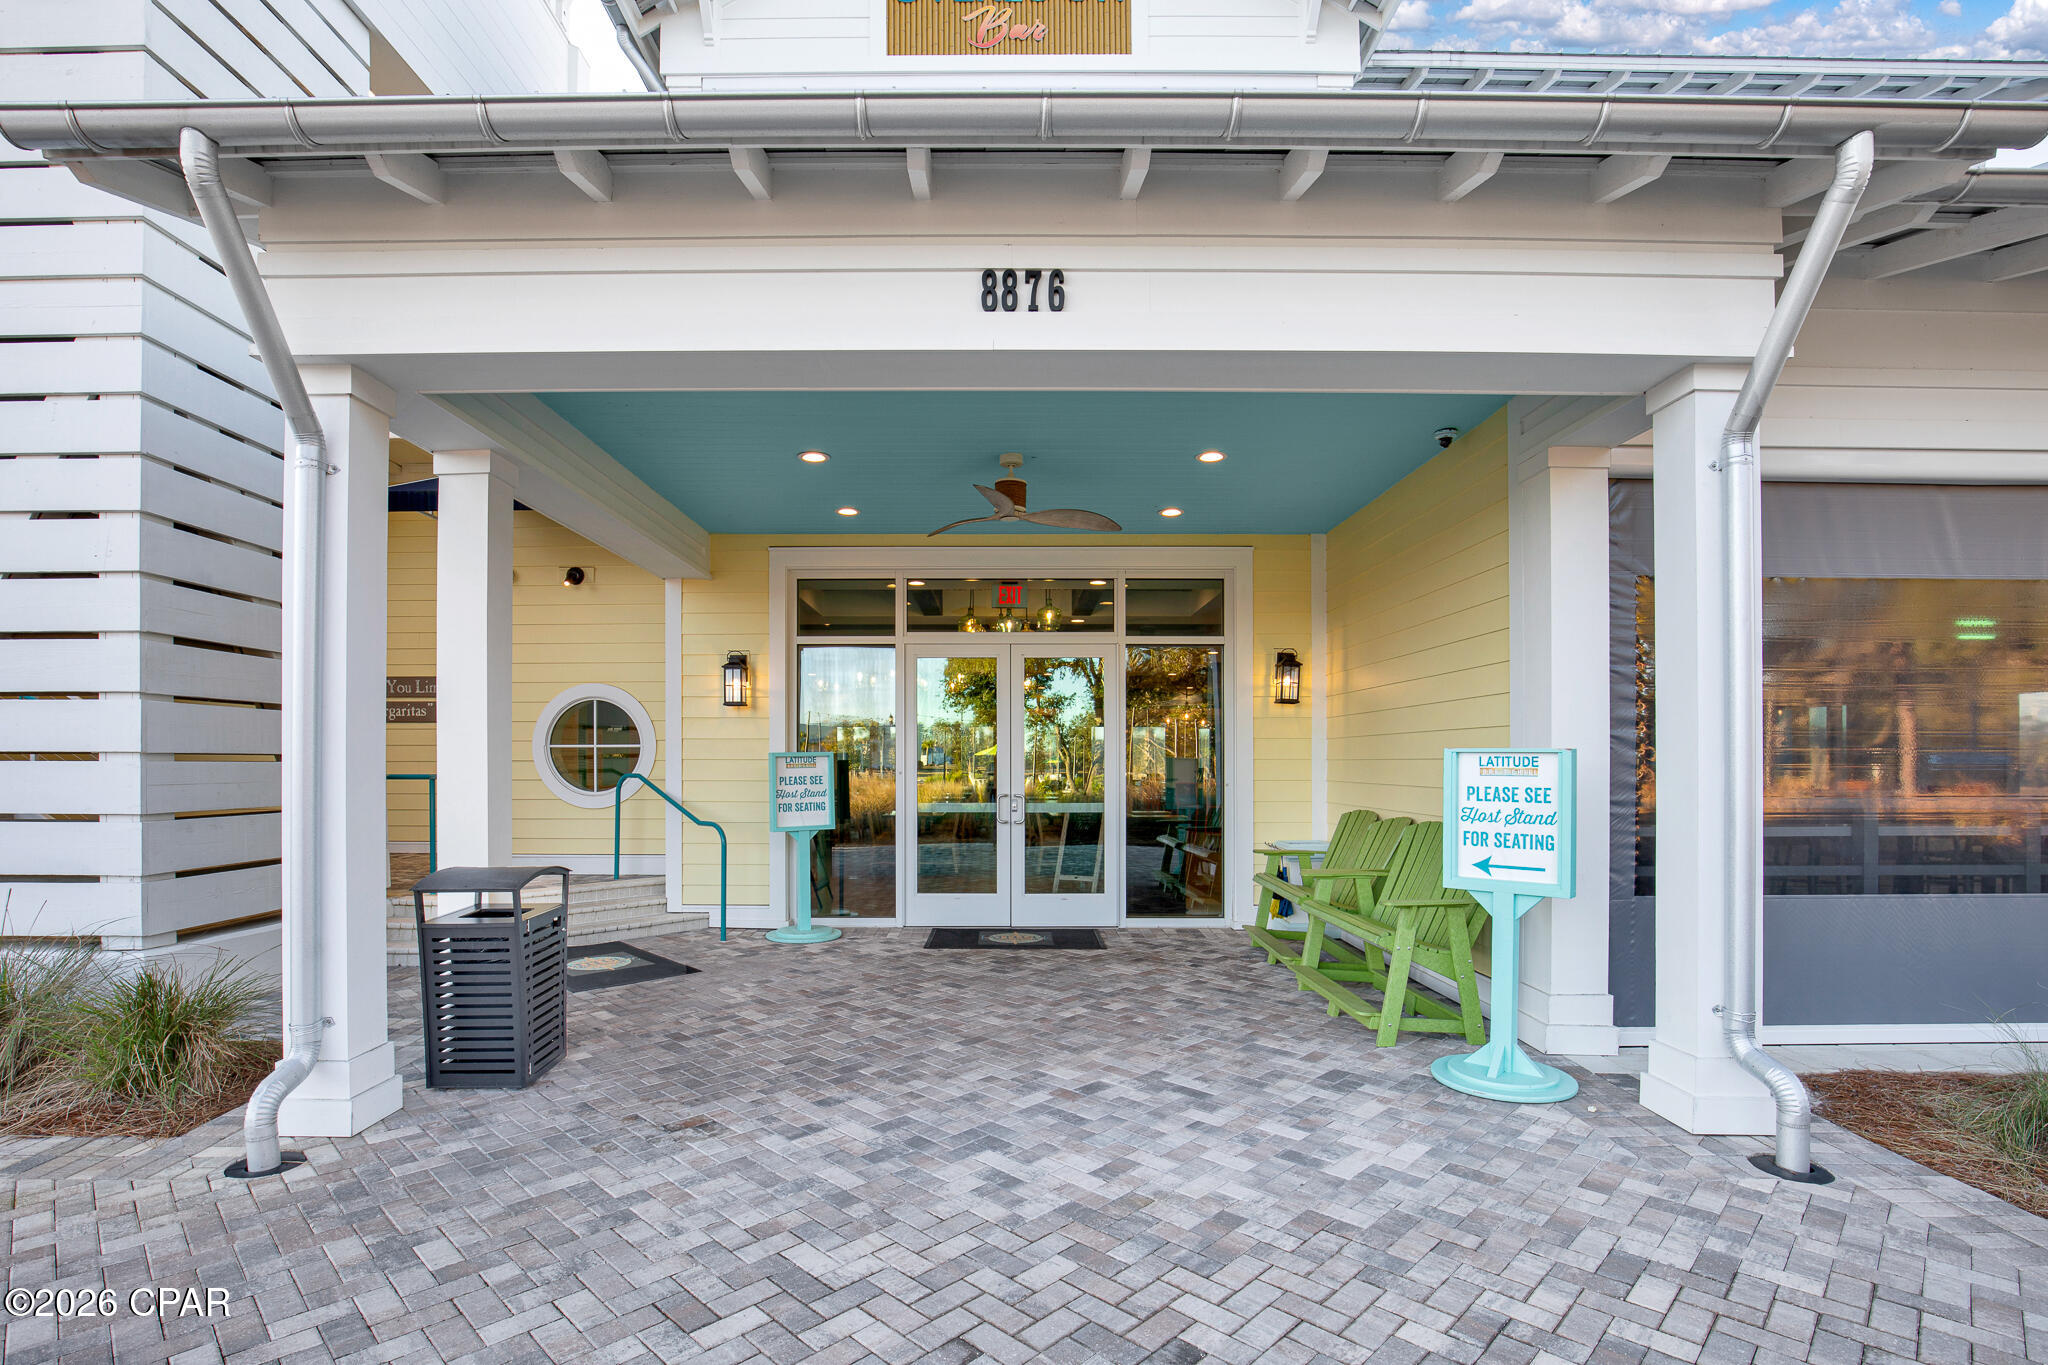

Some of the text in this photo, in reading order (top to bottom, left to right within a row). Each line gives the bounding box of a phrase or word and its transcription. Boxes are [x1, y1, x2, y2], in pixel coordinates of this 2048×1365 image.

[962, 5, 1049, 48] Bar
[981, 269, 1065, 312] 8876
[999, 585, 1023, 604] EXIT
[387, 679, 411, 693] You
[785, 755, 816, 763] LATITUDE
[1479, 756, 1539, 768] LATITUDE
[779, 775, 823, 786] PLEASE SEE
[775, 787, 827, 799] Host Stand
[1466, 786, 1552, 804] PLEASE SEE
[778, 801, 826, 813] FOR SEATING
[1460, 806, 1558, 827] Host Stand
[1463, 830, 1555, 852] FOR SEATING
